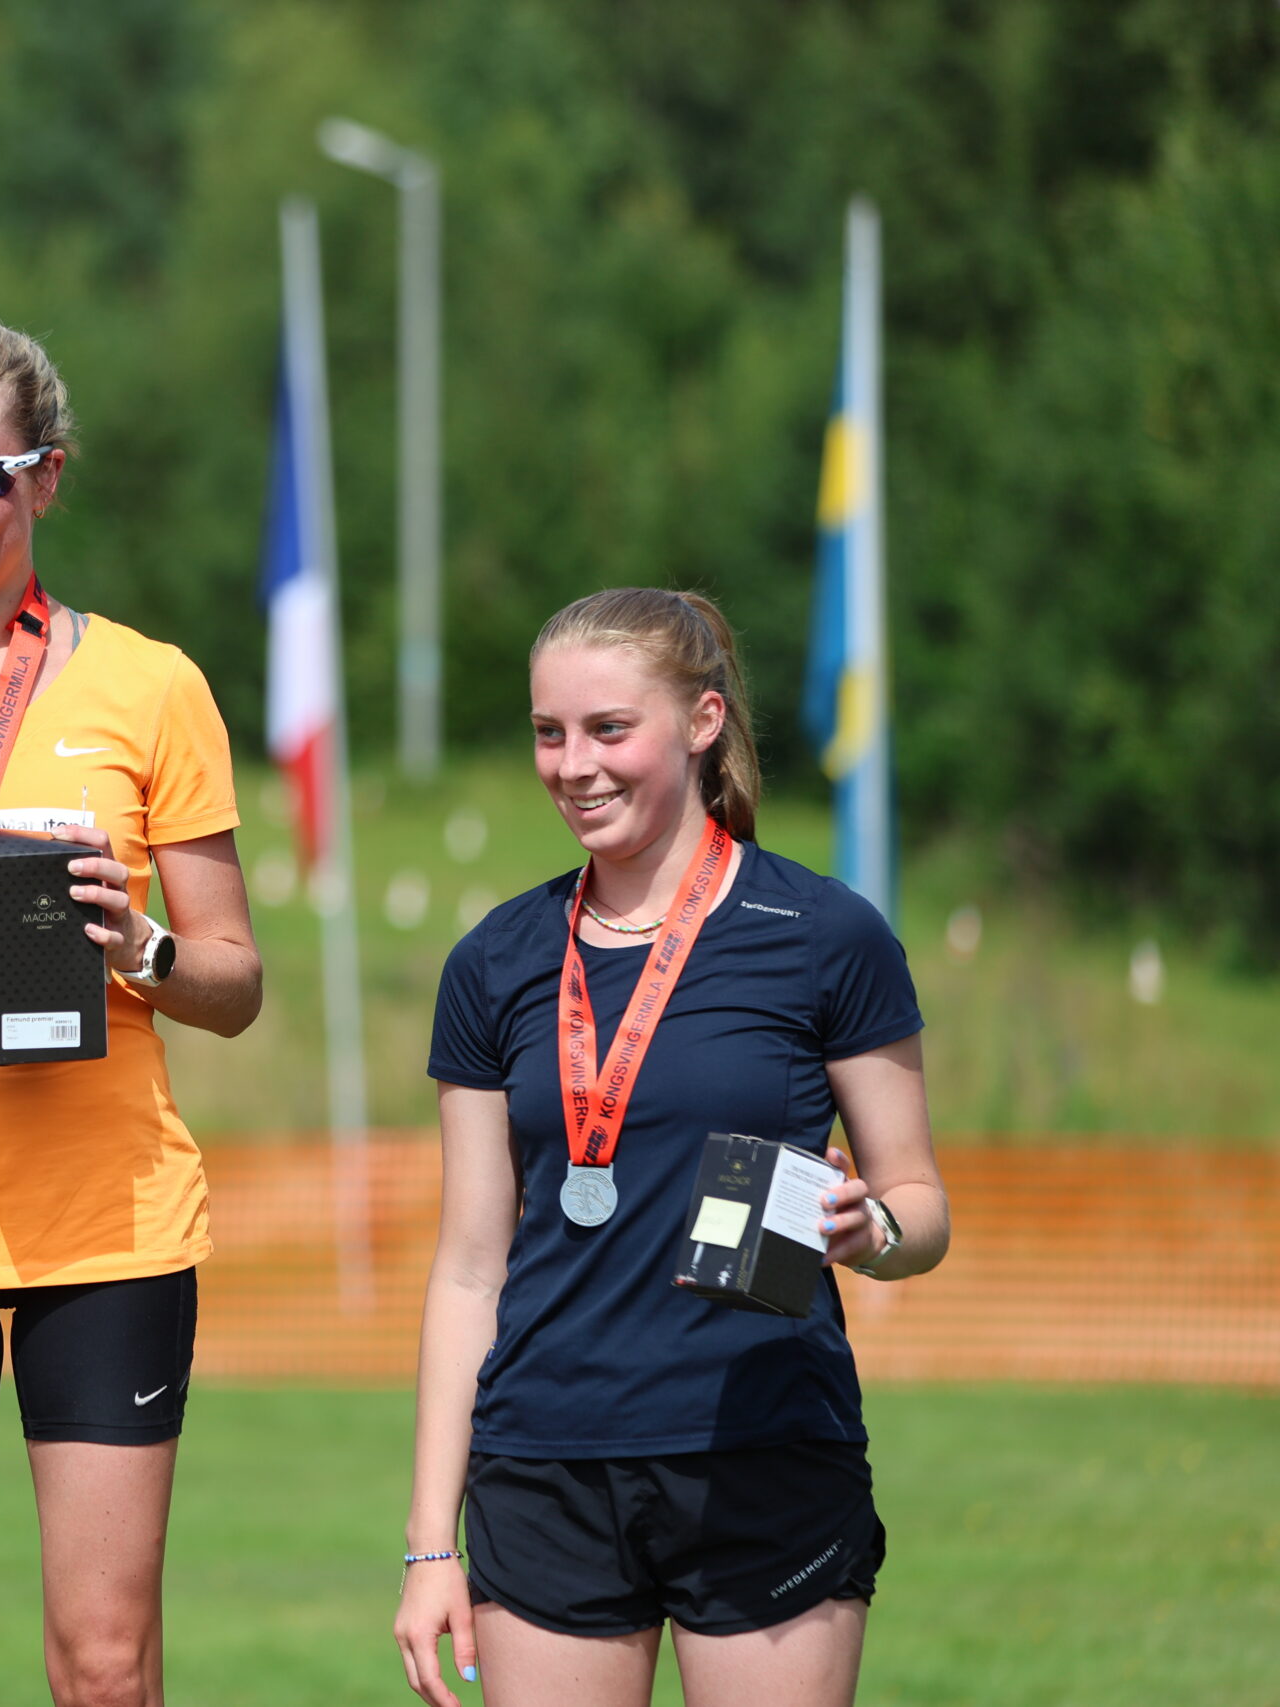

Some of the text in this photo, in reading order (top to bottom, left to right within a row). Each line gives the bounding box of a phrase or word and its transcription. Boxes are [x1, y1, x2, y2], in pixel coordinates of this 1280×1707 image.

[22, 911, 67, 923] MAGNOR
[599, 981, 665, 1119] KONGSVINGERMILA
[770, 1543, 840, 1600] SWEDEMOUNT
